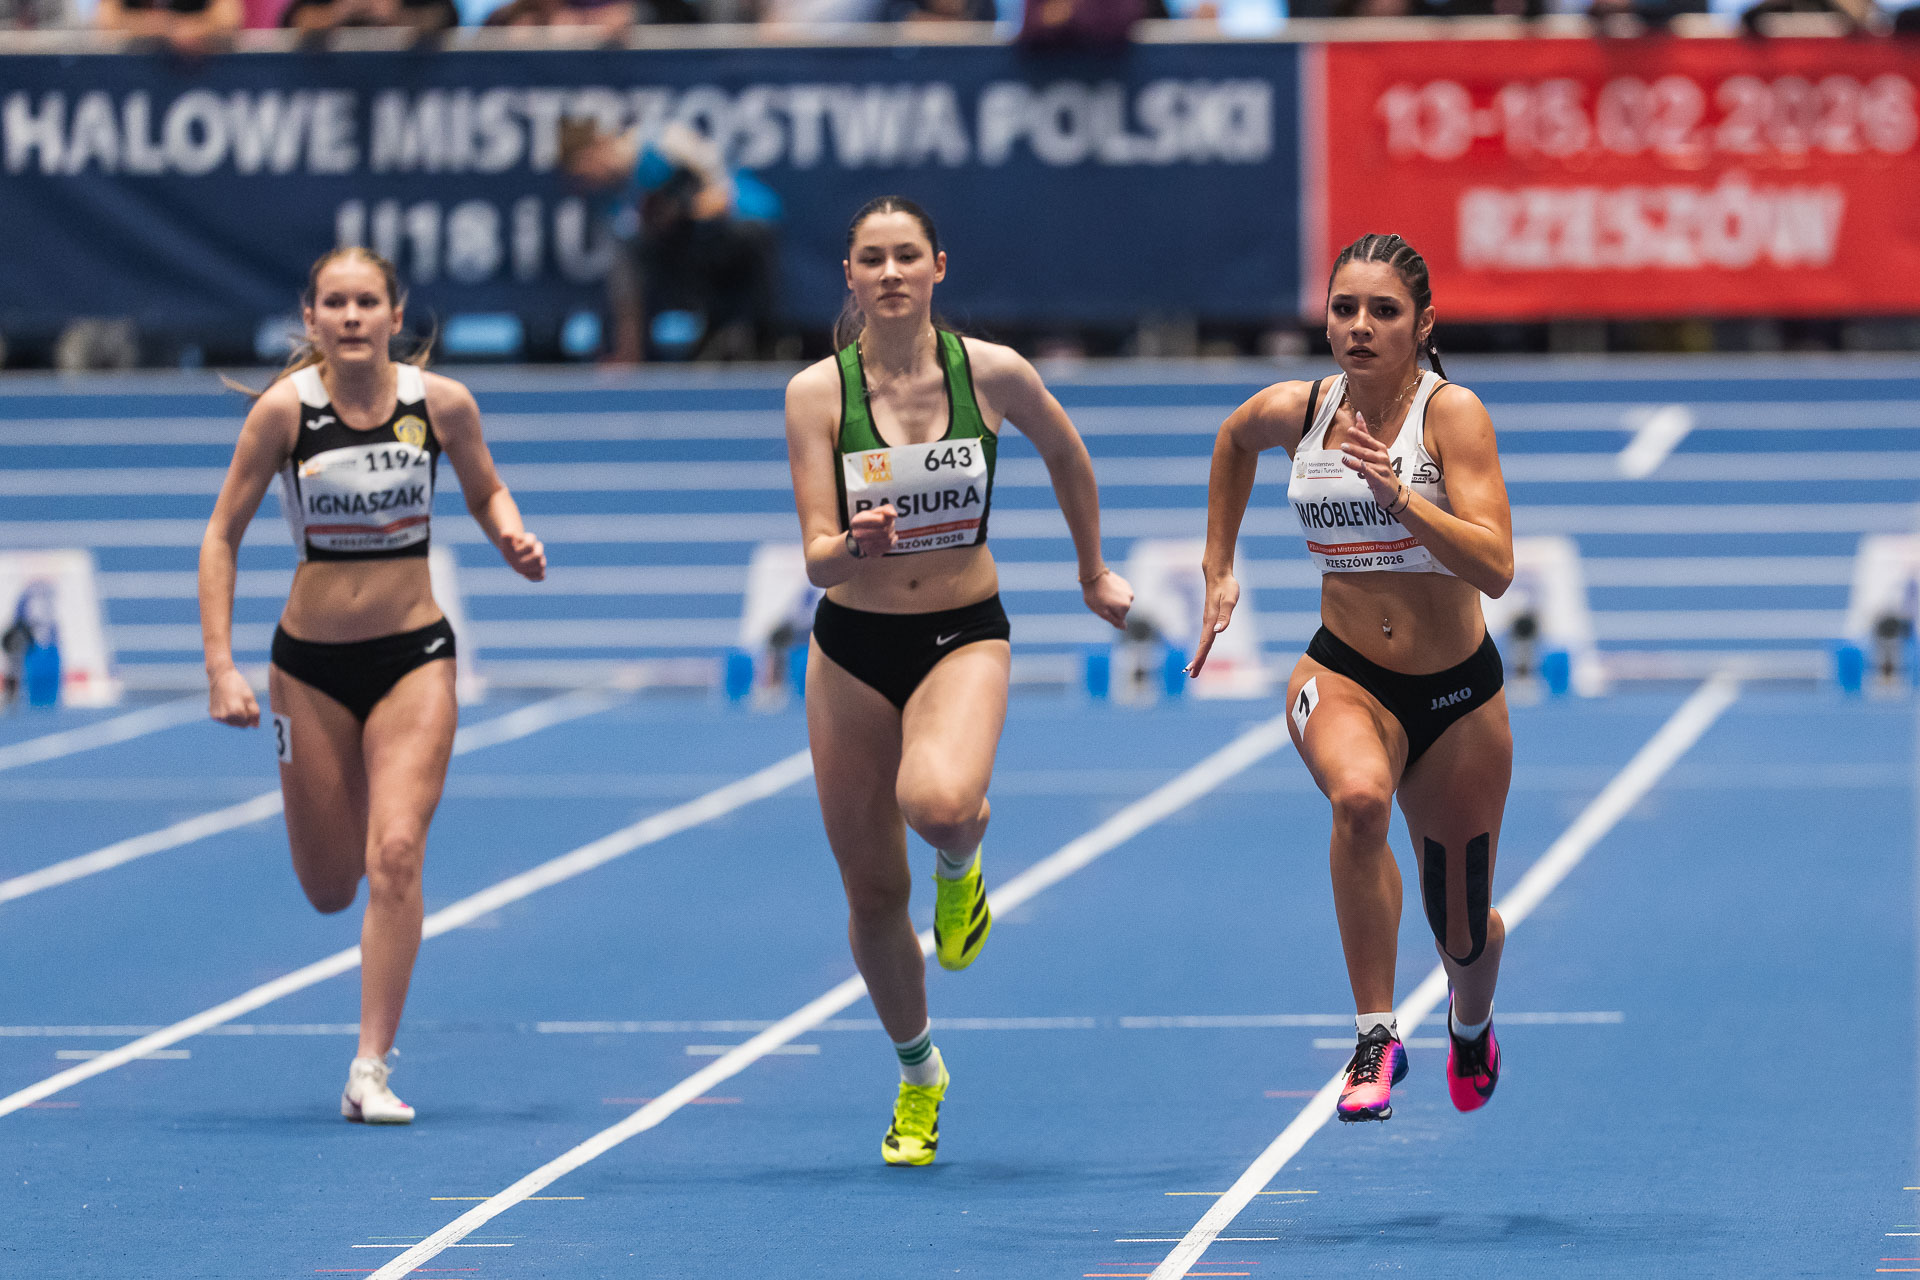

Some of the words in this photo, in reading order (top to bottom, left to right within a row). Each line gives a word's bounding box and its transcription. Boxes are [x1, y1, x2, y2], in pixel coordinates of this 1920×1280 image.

[4, 91, 358, 174] HALOWE
[978, 79, 1273, 166] POLSKI
[1457, 166, 1846, 270] RZESZÓW
[366, 450, 425, 472] 1192
[924, 446, 972, 471] 643
[308, 485, 424, 515] IGNASZAK
[1295, 497, 1401, 528] WRÓBLEWSK
[896, 537, 933, 549] SZÓW
[936, 532, 964, 545] 2026
[1325, 556, 1373, 568] RZESZÓW
[1376, 555, 1404, 566] 2026
[1431, 687, 1472, 710] JAKO
